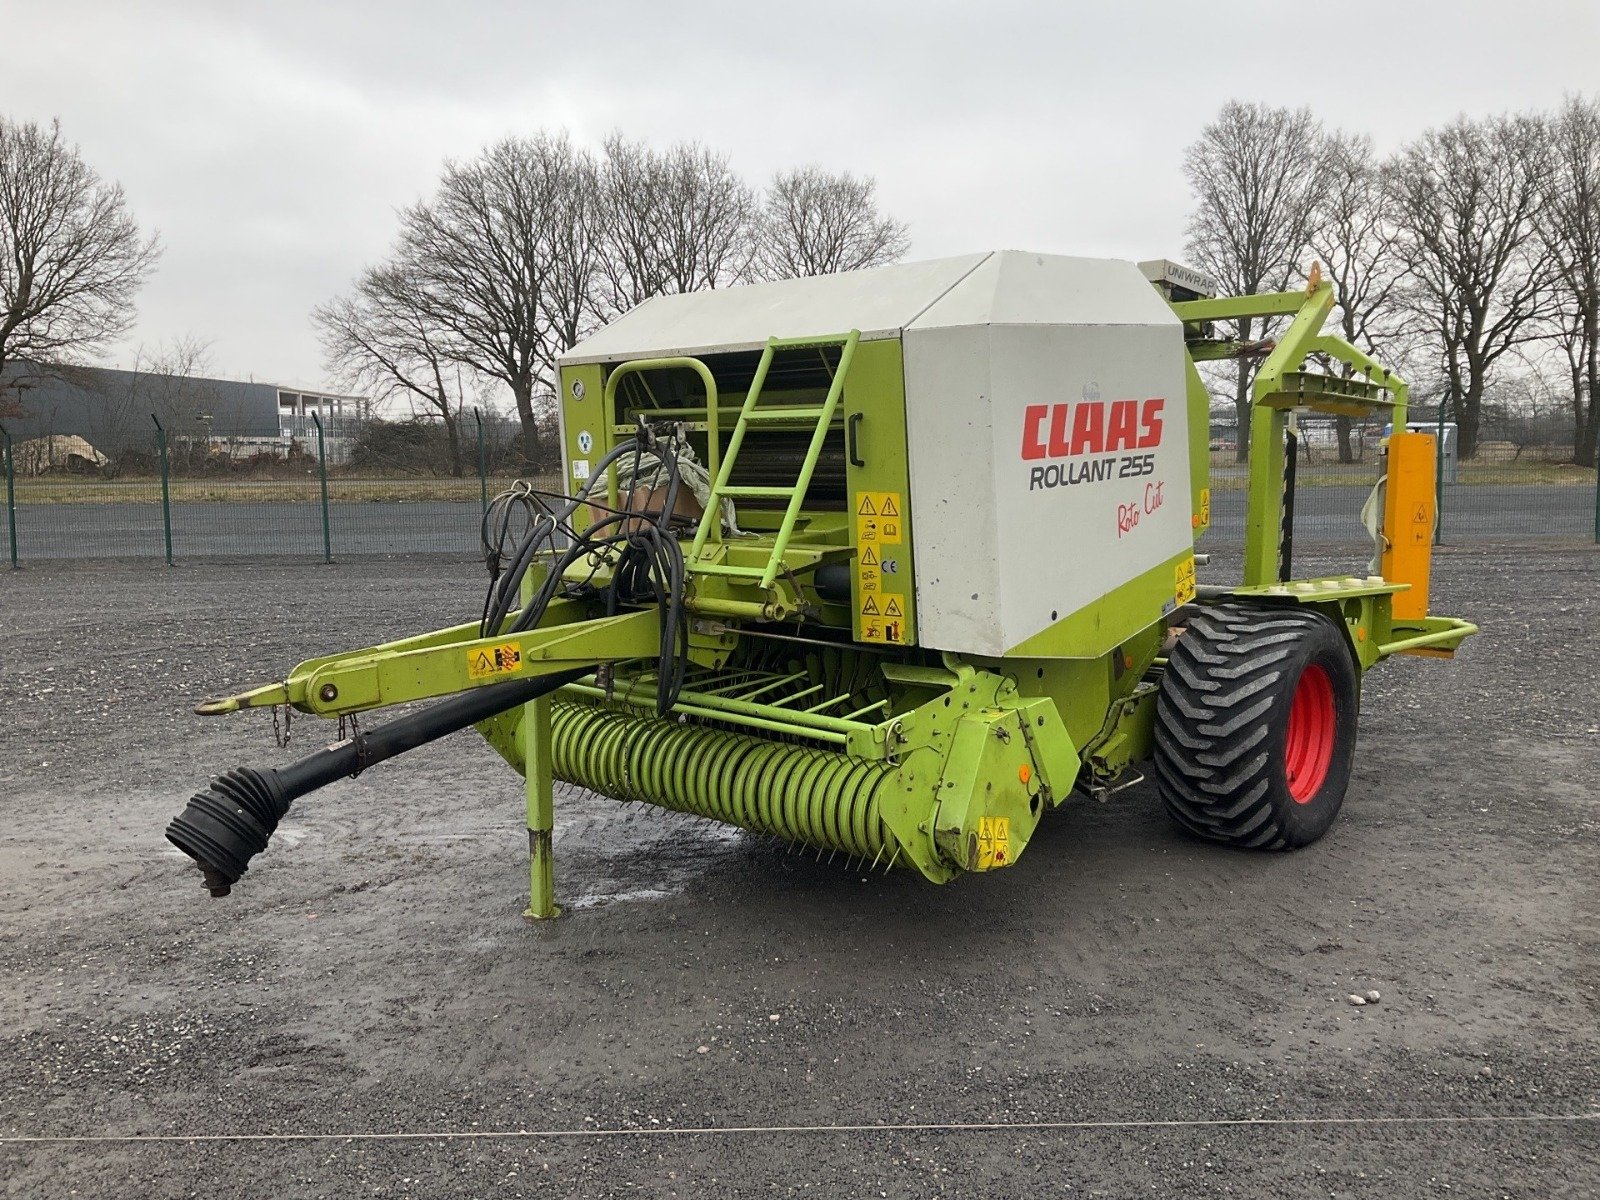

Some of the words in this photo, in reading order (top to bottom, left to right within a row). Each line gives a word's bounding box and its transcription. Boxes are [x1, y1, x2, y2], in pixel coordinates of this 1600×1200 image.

[1167, 265, 1215, 290] UNIWRAP
[1021, 398, 1165, 461] CLAAS
[1029, 457, 1117, 491] ROLLANT
[1118, 453, 1155, 479] 255
[1117, 502, 1140, 539] Roto
[1144, 480, 1165, 515] Cut
